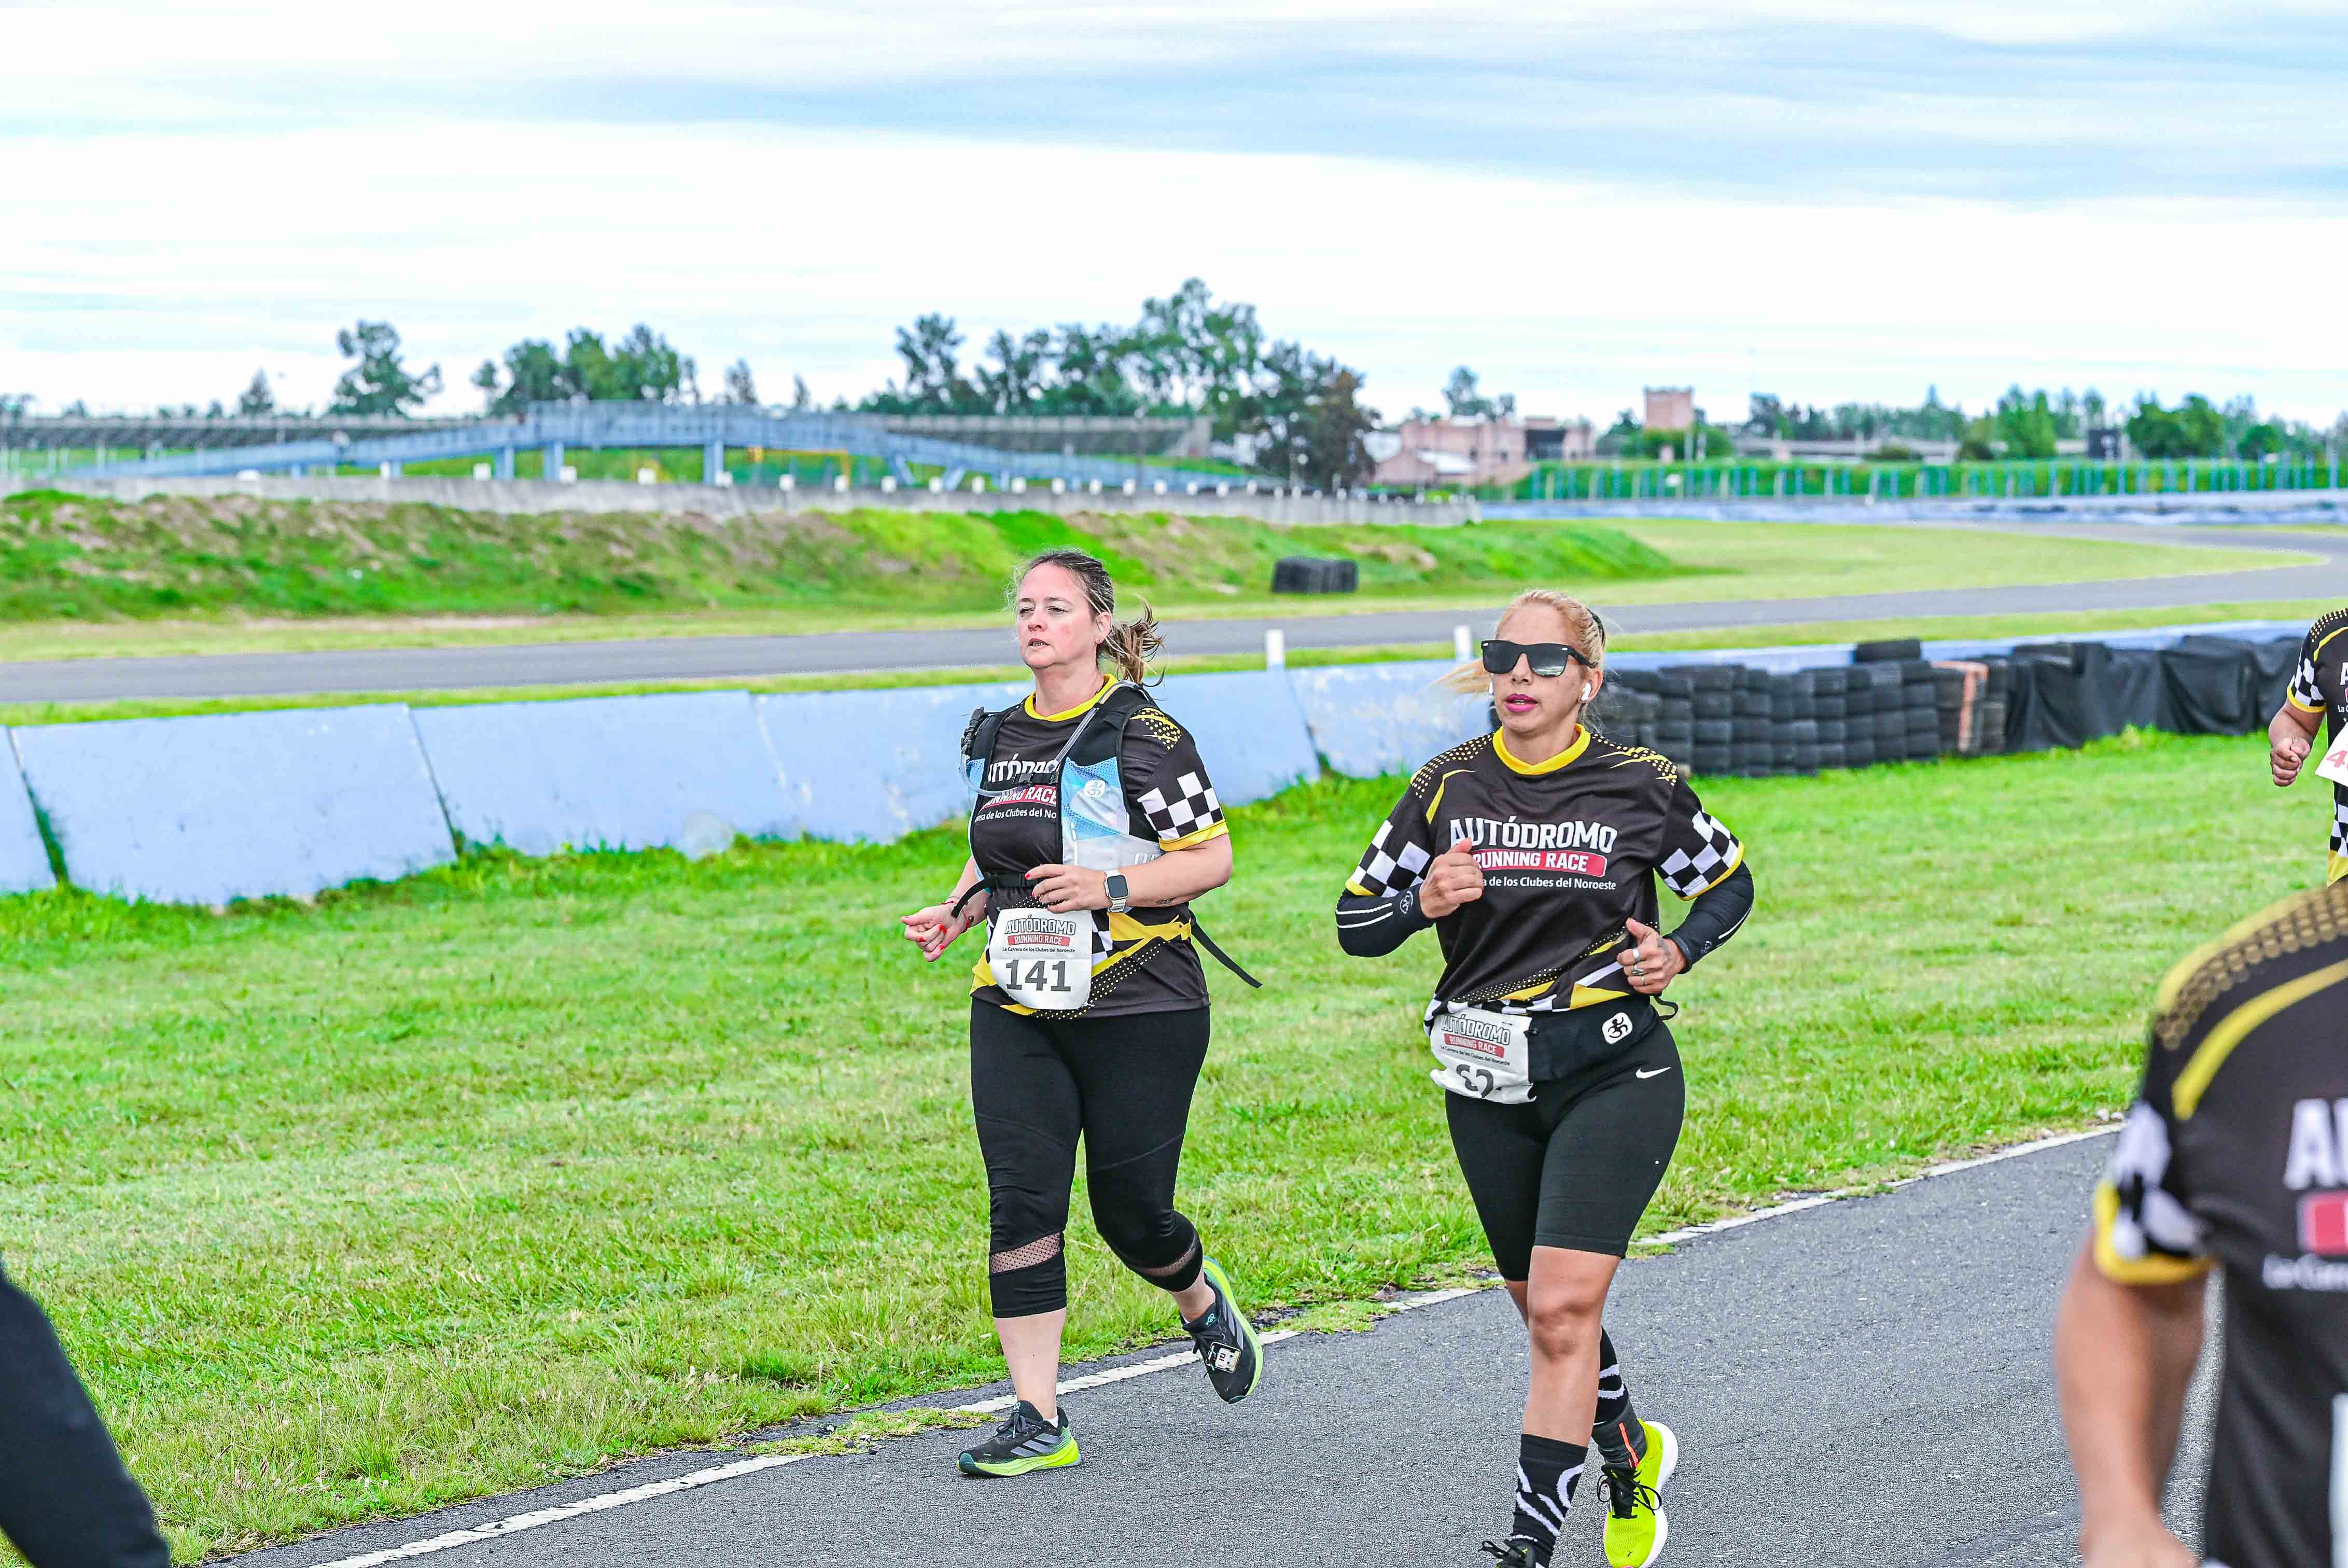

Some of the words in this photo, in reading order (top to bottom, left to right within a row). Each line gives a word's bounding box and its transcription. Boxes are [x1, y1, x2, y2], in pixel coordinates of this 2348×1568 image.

[986, 811, 994, 820] de
[995, 810, 1005, 819] los
[1005, 808, 1027, 818] Clubes
[1029, 807, 1042, 817] del
[1450, 816, 1618, 853] AUTÓDROMO
[1545, 852, 1589, 872] RACE
[1489, 876, 1502, 887] de
[1504, 876, 1518, 887] los
[1519, 877, 1554, 888] Clubes
[1555, 877, 1572, 888] del
[1574, 878, 1616, 890] Noroeste
[1004, 914, 1077, 936] AUTÓDROMO
[1014, 934, 1043, 945] RUNNING
[1044, 935, 1063, 945] RACE
[1006, 959, 1071, 992] 141
[1441, 1014, 1511, 1046] AUTÓDROMO
[1478, 1041, 1497, 1055] RACE
